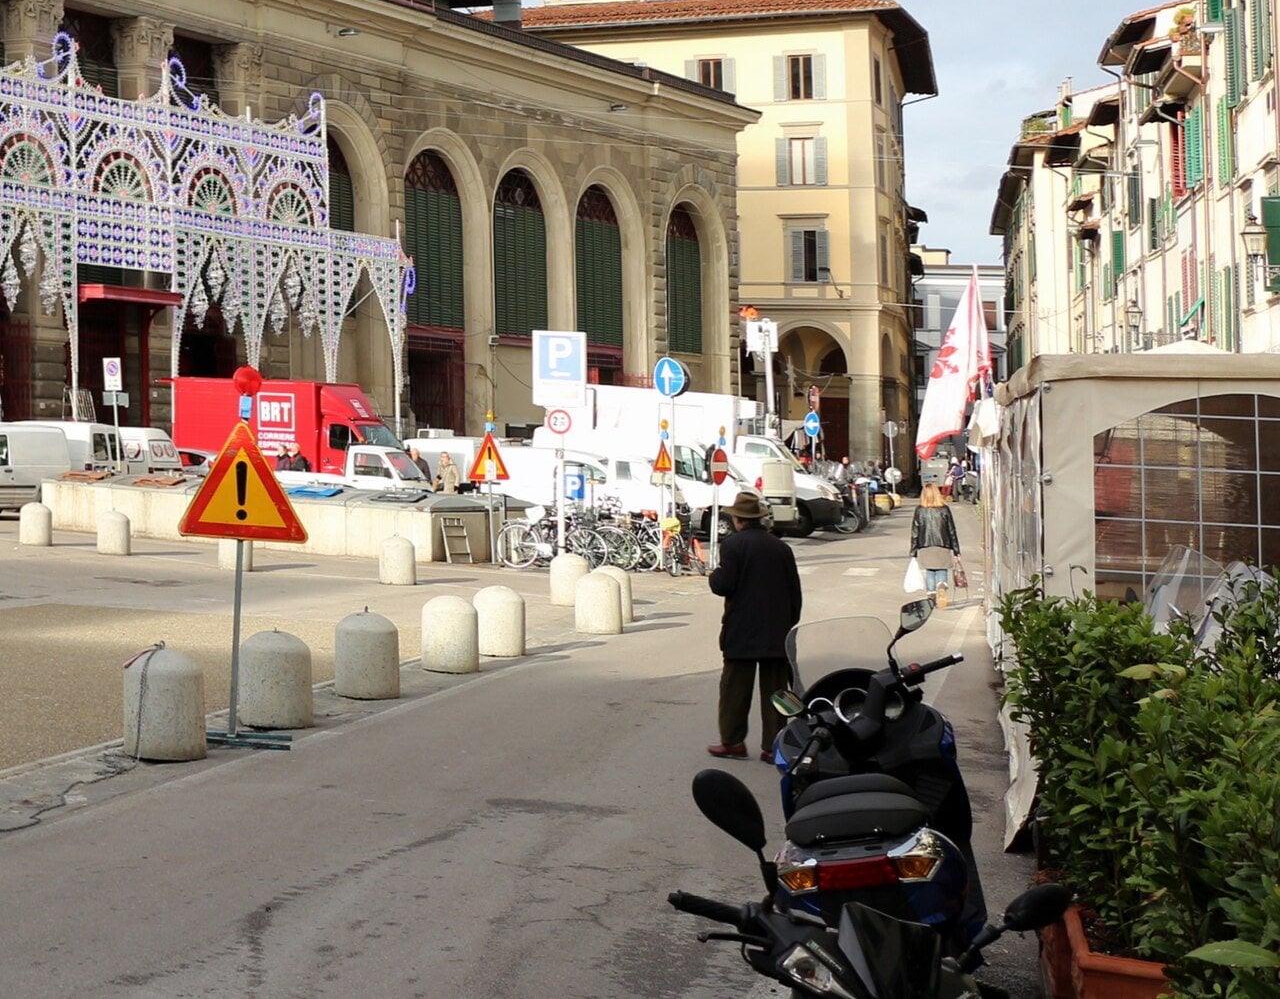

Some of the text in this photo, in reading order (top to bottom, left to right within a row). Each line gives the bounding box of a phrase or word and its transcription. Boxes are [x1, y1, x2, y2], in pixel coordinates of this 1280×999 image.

[548, 337, 572, 369] P
[260, 401, 292, 422] BRT
[258, 432, 296, 441] CORRIERE
[565, 475, 582, 498] P
